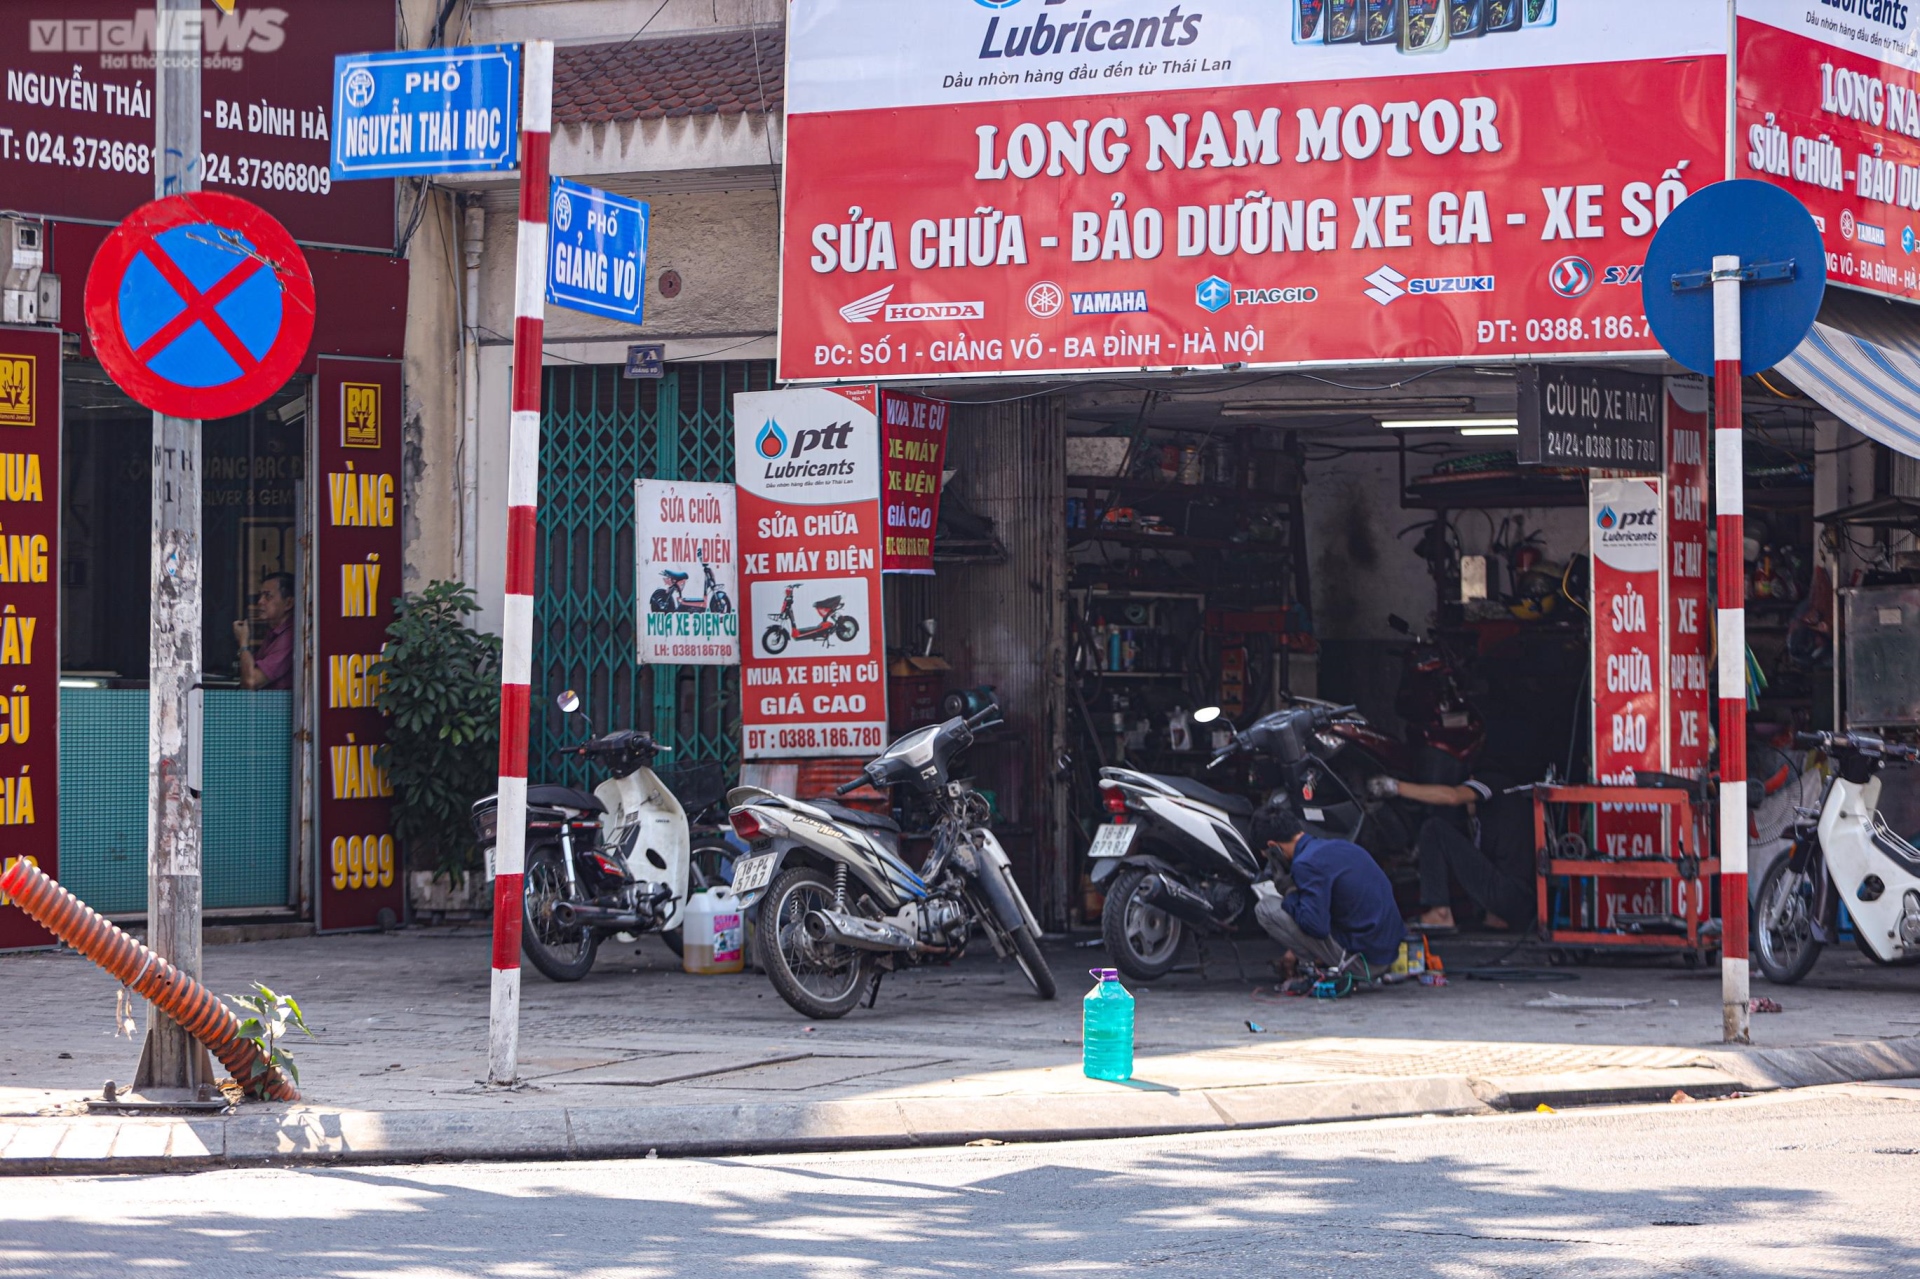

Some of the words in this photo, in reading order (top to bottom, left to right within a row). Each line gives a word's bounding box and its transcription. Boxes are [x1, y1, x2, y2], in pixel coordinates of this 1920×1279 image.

[978, 4, 1203, 60] Lubricants
[405, 60, 461, 94] PHỐ
[943, 71, 973, 89] Dầu
[977, 69, 1019, 87] nhờn
[1024, 67, 1063, 86] hàng
[1068, 62, 1099, 81] đầu
[1103, 59, 1134, 78] đến
[1138, 60, 1158, 76] từ
[1161, 57, 1196, 75] Thái
[1201, 57, 1232, 72] Lan
[7, 64, 98, 112] NGUYỄN
[103, 80, 151, 118] THÁI
[215, 100, 243, 130] BA
[248, 99, 295, 137] ĐÌNH
[300, 106, 329, 141] HÀ
[1820, 62, 1883, 127] LONG
[1886, 82, 1920, 139] NA
[345, 98, 413, 157] NGUYỄN
[419, 103, 458, 152] THÁI
[465, 107, 501, 159] HỌC
[974, 117, 1130, 180] LONG
[1145, 107, 1282, 171] NAM
[1295, 96, 1503, 163] MOTOR
[1749, 112, 1789, 177] SỬA
[1792, 134, 1844, 192] CHỮA
[1857, 143, 1896, 205] BẢO
[587, 207, 618, 237] PHỐ
[810, 205, 898, 273] SỬA
[909, 205, 1028, 269] CHỮA
[1040, 236, 1059, 248] -
[1071, 191, 1163, 262] BẢO
[1177, 189, 1337, 257] DƯỠNG
[1350, 194, 1413, 250] XE
[1427, 190, 1492, 246] GA
[1506, 213, 1526, 226] -
[1540, 184, 1605, 241] XE
[555, 230, 608, 295] GIẢNG
[612, 251, 636, 301] VÕ
[1840, 252, 1853, 276] VÕ
[1860, 259, 1873, 280] BA
[1071, 290, 1148, 314] YAMAHA
[1235, 288, 1318, 305] PIAGGIO
[1408, 276, 1494, 294] SUZUKI
[889, 304, 980, 319] HONDA
[1477, 319, 1517, 343] ĐT:
[1526, 315, 1652, 342] 0388.186.7
[815, 345, 854, 366] ĐC:
[860, 334, 891, 364] SỐ
[898, 343, 907, 362] 1
[929, 332, 1003, 362] GIẢNG
[1010, 331, 1043, 360] VÕ
[1063, 337, 1096, 358] BA
[1103, 328, 1161, 357] ĐÌNH
[1183, 326, 1216, 354] HÀ
[1224, 324, 1264, 356] NỘI
[911, 402, 926, 428] XE
[929, 401, 946, 431] CŨ
[1546, 375, 1577, 416] CỨU
[1581, 378, 1600, 429] HỘ
[1604, 389, 1621, 419] XE
[1625, 383, 1656, 424] MÁY
[790, 420, 854, 459] ptt
[888, 437, 903, 459] XE
[904, 438, 939, 463] MÁY
[1548, 432, 1583, 456] 24/24:
[1585, 436, 1612, 458] 0388
[1615, 438, 1634, 461] 186
[1636, 438, 1656, 462] 780
[1672, 428, 1701, 465] MUA
[764, 459, 855, 479] Lubricants
[888, 470, 902, 490] XE
[328, 460, 394, 527] VÀNG
[660, 487, 685, 524] SỬA
[688, 492, 722, 524] CHỮA
[1673, 479, 1701, 522] BÁN
[757, 510, 798, 539] SỬA
[804, 510, 859, 537] CHỮA
[887, 501, 907, 527] GIÁ
[1619, 508, 1657, 530] ptt
[652, 536, 669, 562] XE
[671, 532, 699, 563] MÁY
[700, 534, 731, 569] ĐIỆN
[1602, 530, 1658, 542] Lubricants
[744, 553, 769, 575] XE
[776, 547, 819, 574] MÁY
[825, 544, 874, 577] ĐIỆN
[1673, 541, 1684, 577] XE
[341, 552, 381, 617] MỸ
[647, 613, 672, 637] MUA
[675, 613, 690, 635] XE
[692, 609, 720, 641] ĐIỆN
[1611, 582, 1647, 633] SỬA
[1678, 597, 1698, 635] XE
[0, 604, 37, 665] ÂY
[654, 645, 670, 656] LH:
[672, 644, 732, 656] 0388186780
[746, 666, 782, 686] MUA
[787, 665, 807, 684] XE
[812, 659, 851, 687] ĐIỆN
[856, 660, 879, 682] CŨ
[1606, 647, 1652, 693] CHỮA
[760, 693, 805, 716] GIÁ
[812, 694, 866, 713] CAO
[748, 731, 765, 749] ĐT
[779, 727, 881, 748] 0388.186.780
[1612, 702, 1647, 753] BẢO
[1679, 709, 1699, 747] XE
[331, 833, 395, 890] 9999
